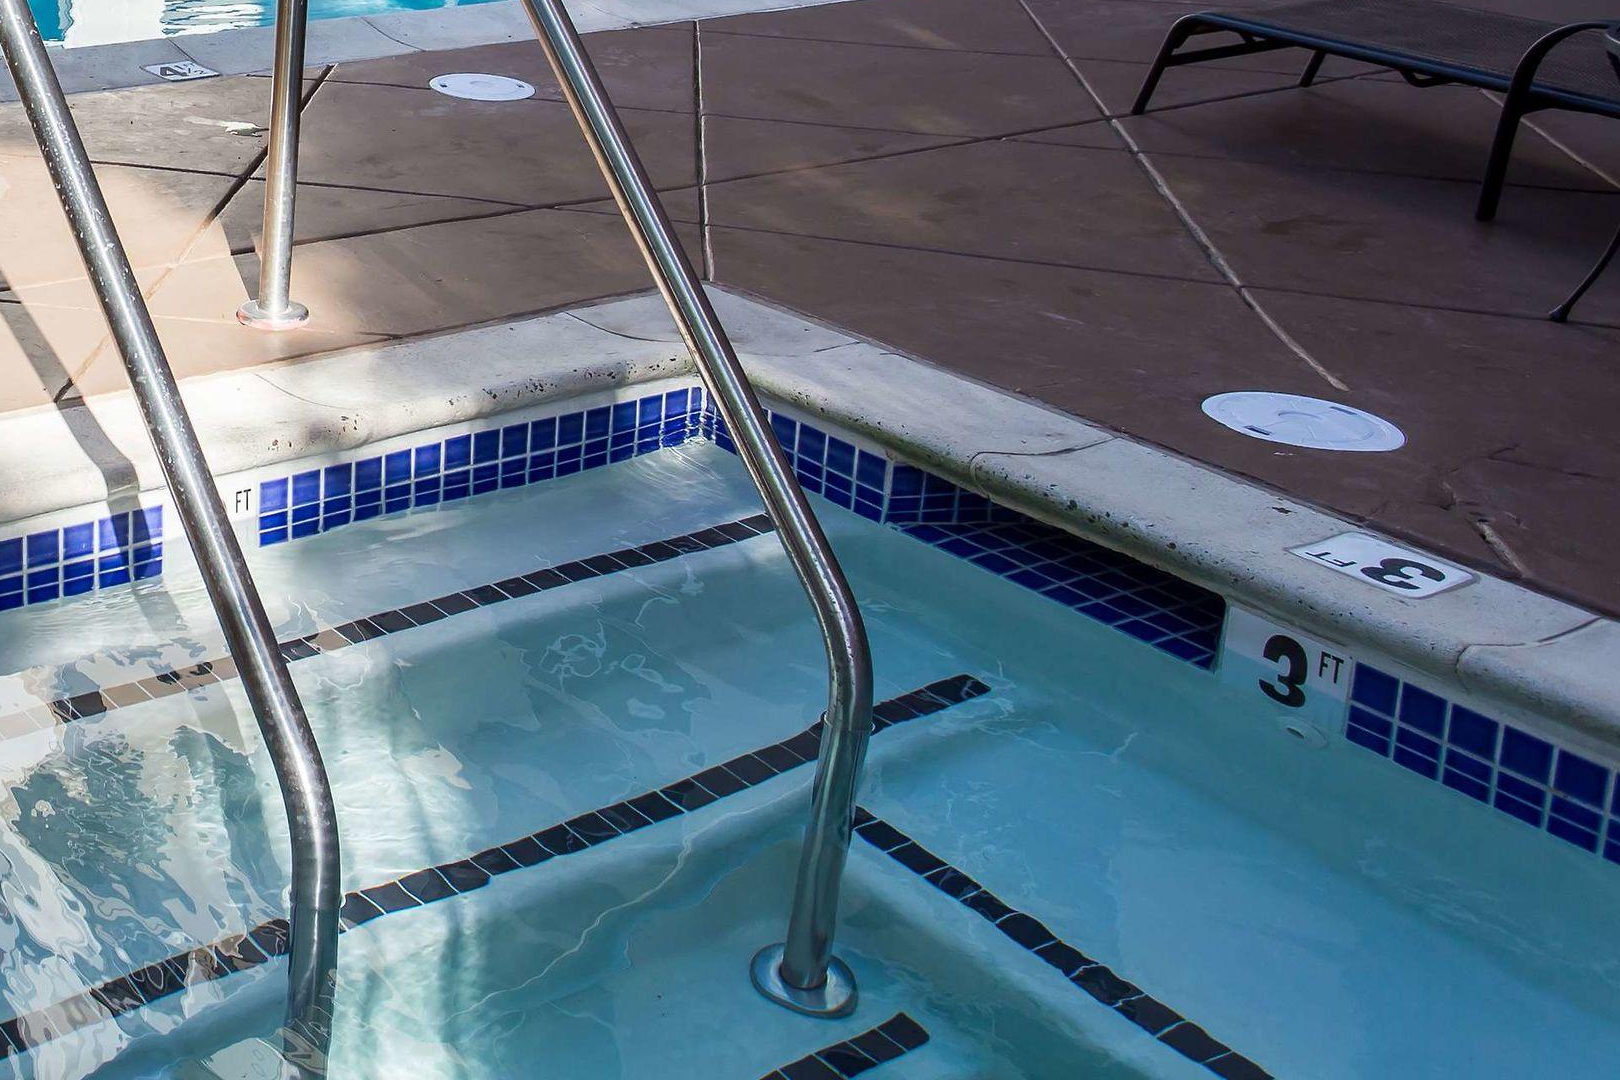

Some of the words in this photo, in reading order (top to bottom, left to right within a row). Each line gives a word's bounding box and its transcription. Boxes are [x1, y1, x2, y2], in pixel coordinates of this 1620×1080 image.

[235, 488, 252, 514] FT
[1305, 550, 1357, 568] FT
[1361, 557, 1447, 590] 3
[1258, 634, 1309, 708] 3
[1318, 651, 1345, 684] FT
